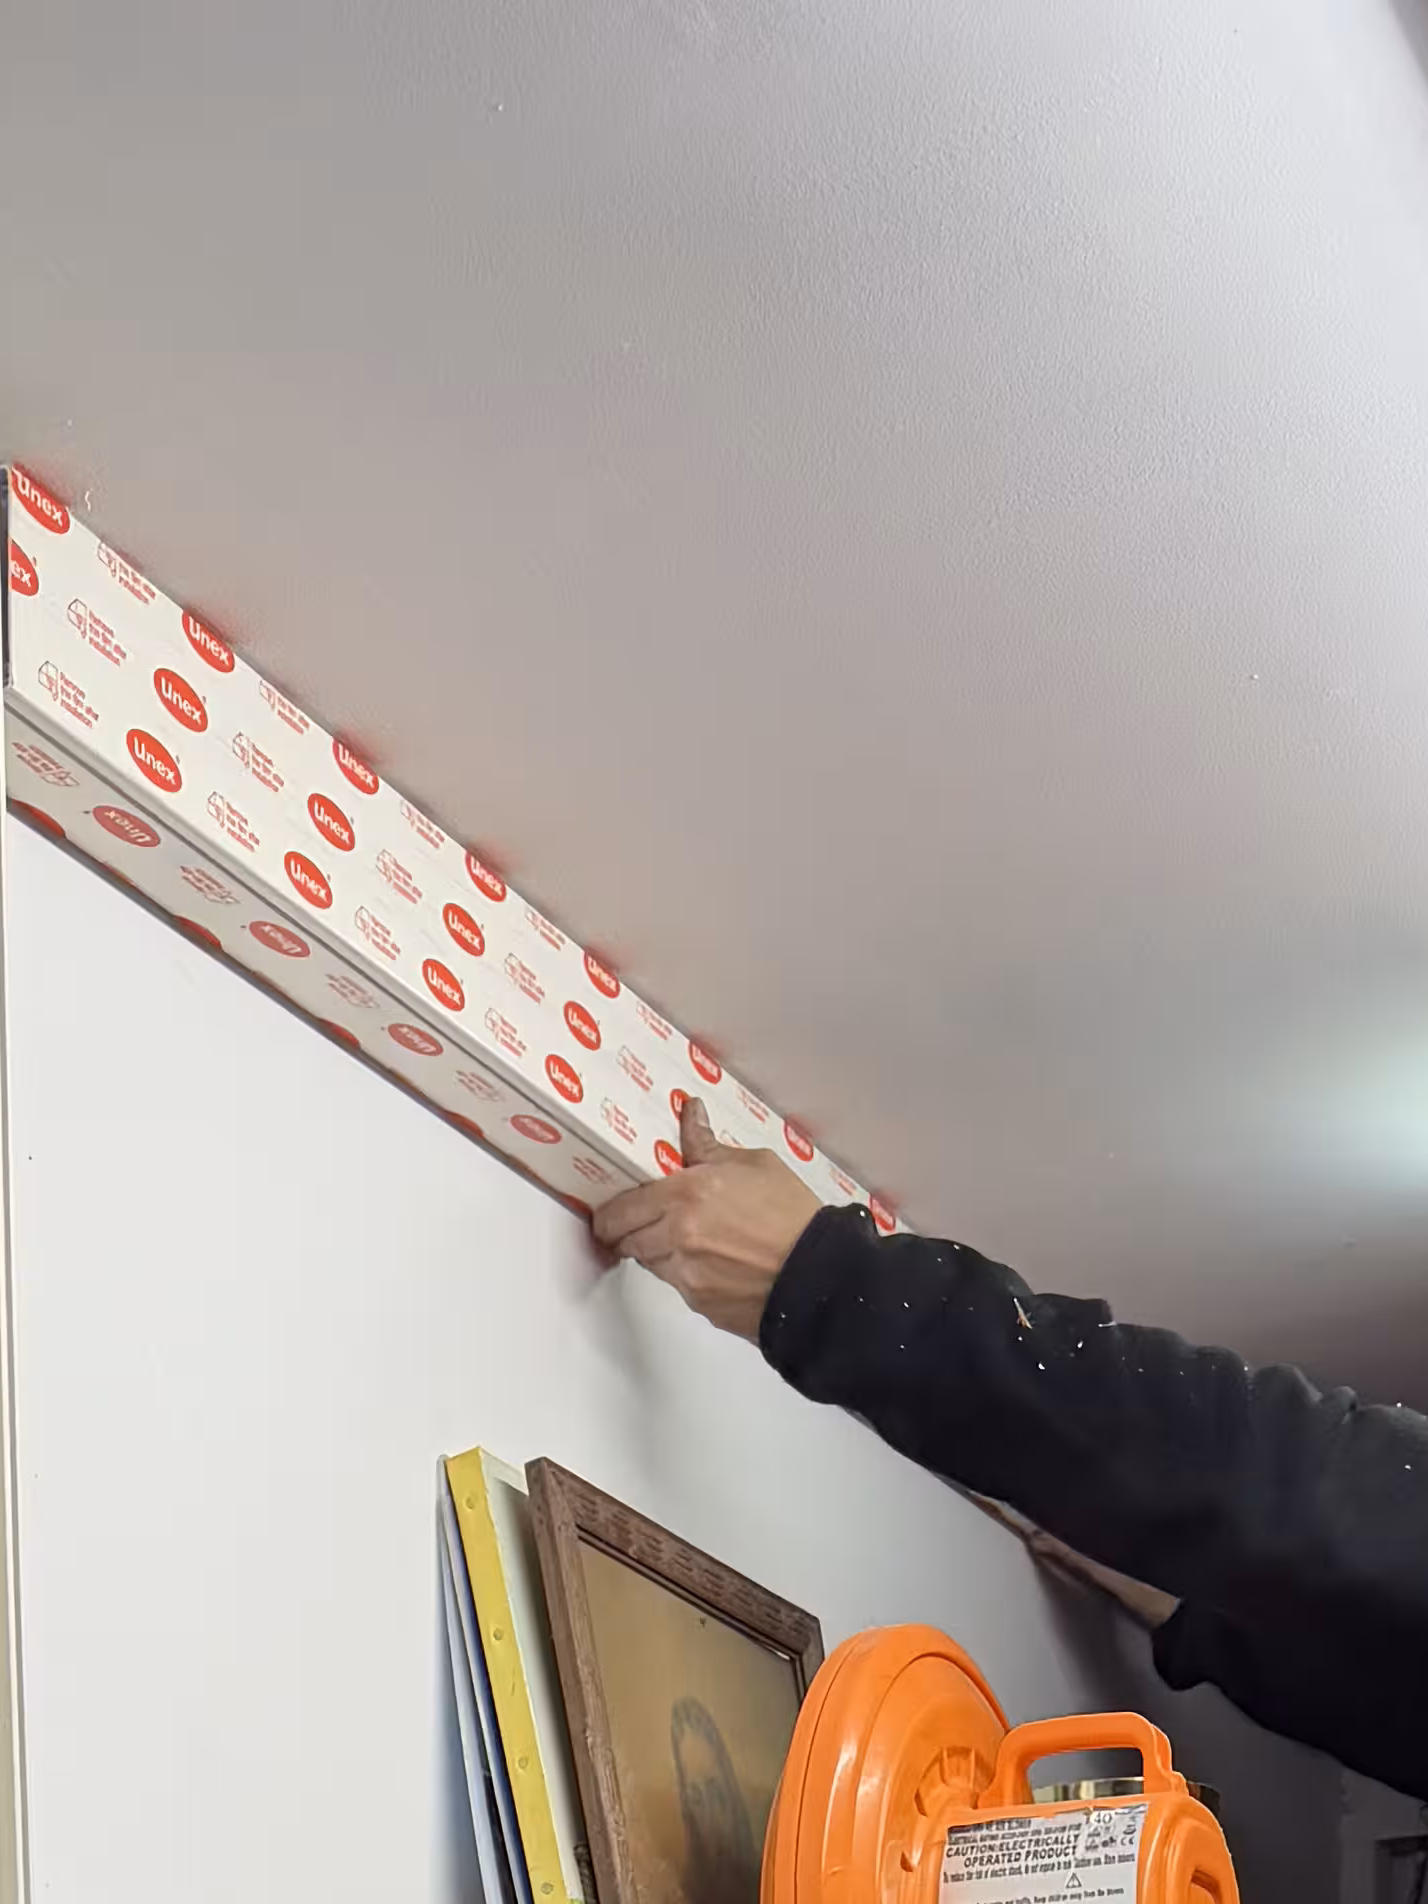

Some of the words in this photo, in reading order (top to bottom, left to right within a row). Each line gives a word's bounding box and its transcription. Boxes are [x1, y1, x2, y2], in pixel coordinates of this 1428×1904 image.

[14, 470, 64, 527] Unex
[11, 559, 31, 587] ex
[188, 616, 228, 665] Unex
[161, 677, 200, 724] Unex
[134, 737, 174, 785] Unex
[105, 810, 150, 842] Unex
[314, 803, 349, 844] Unex
[290, 861, 327, 902] Unex
[448, 911, 481, 949] Unex
[428, 970, 462, 1004] Unex
[549, 1061, 579, 1099] Unex
[964, 1851, 1021, 1868] OPERATED
[1025, 1845, 1077, 1861] PRODUCT
